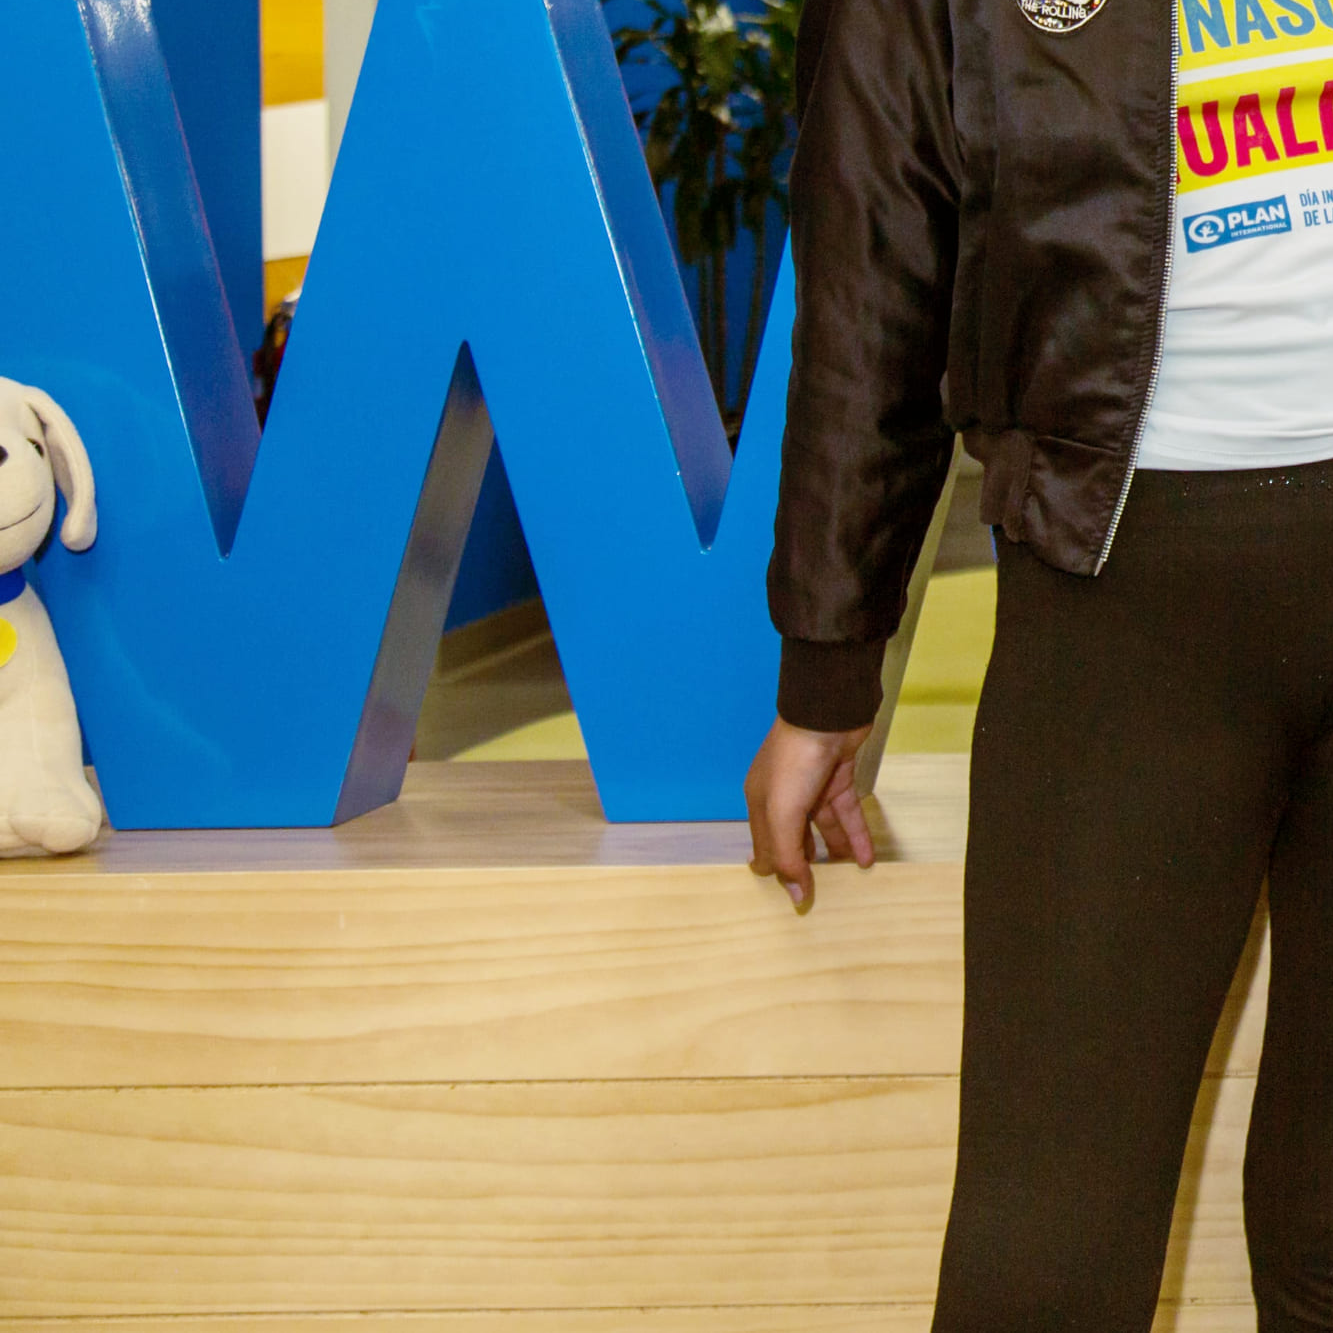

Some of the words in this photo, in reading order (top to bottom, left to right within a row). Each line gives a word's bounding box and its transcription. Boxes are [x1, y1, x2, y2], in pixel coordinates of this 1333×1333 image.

[1041, 4, 1087, 20] ROLLING
[1299, 188, 1320, 207] DÍA
[1227, 204, 1286, 229] PLAN
[1304, 210, 1321, 227] DE
[1230, 223, 1288, 238] INTERNATIONAL
